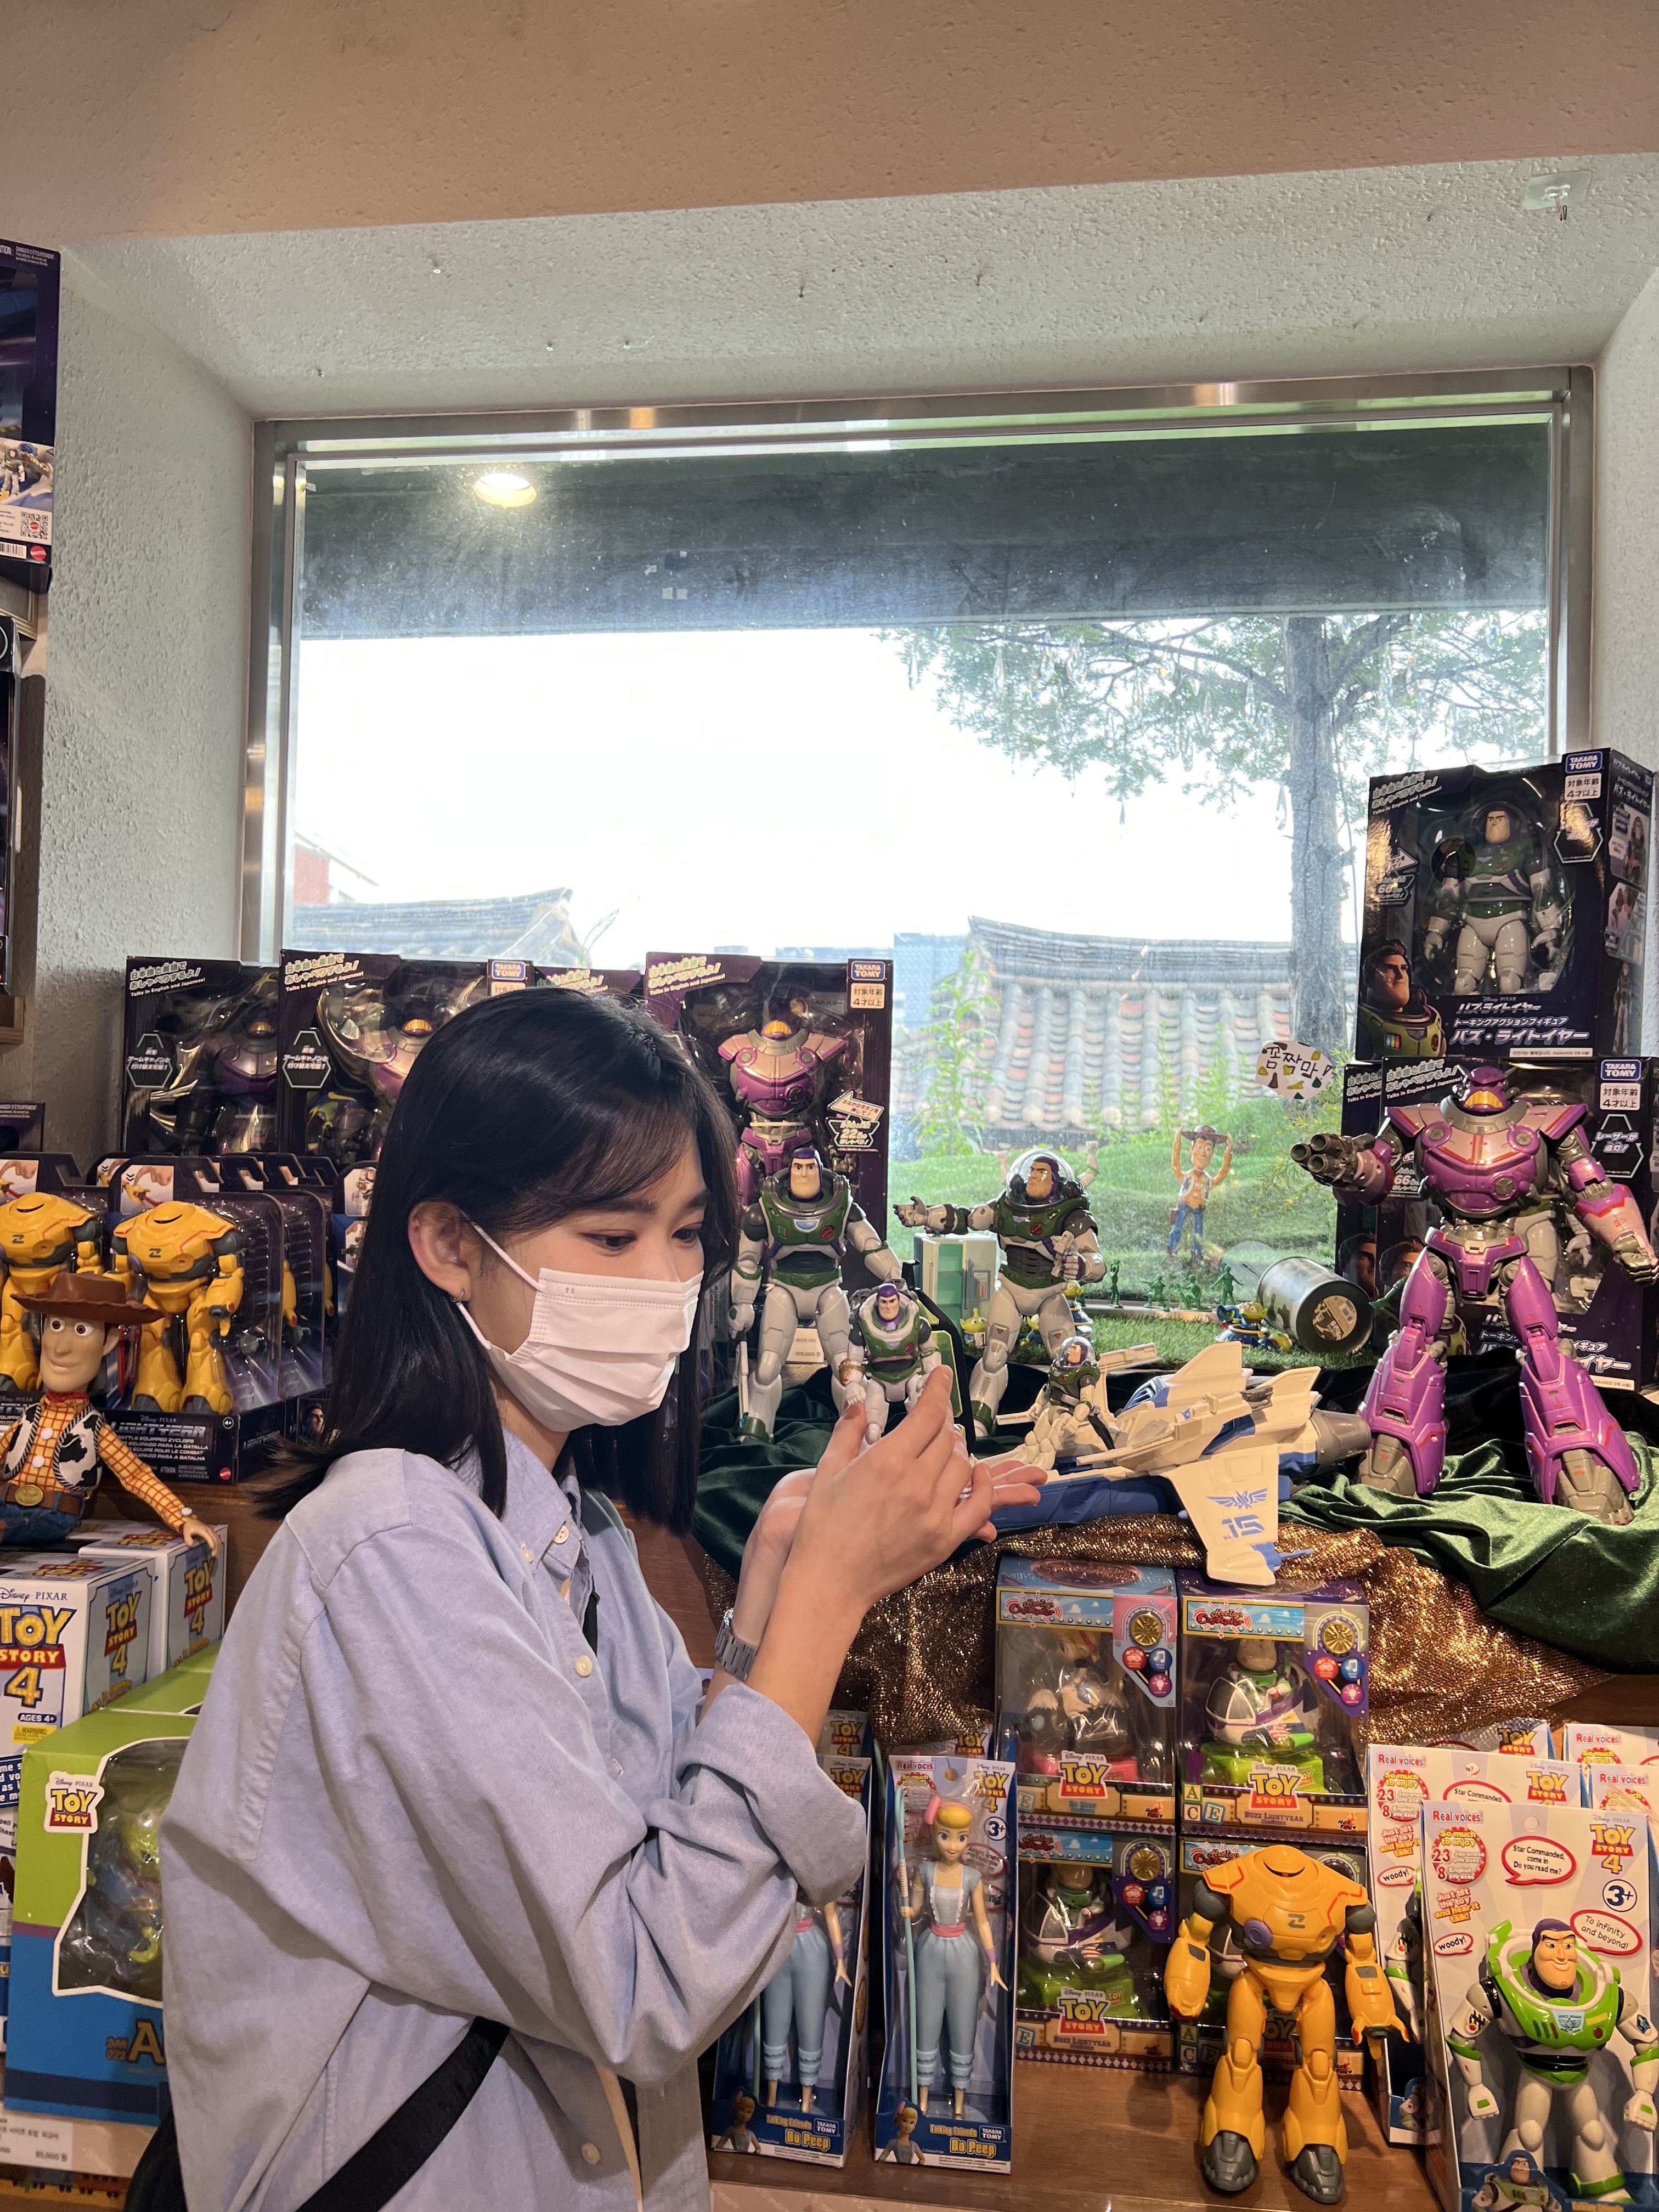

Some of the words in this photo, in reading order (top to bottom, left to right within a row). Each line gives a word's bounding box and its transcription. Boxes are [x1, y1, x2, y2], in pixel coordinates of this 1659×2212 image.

[1569, 761, 1597, 770] TOMY
[1567, 778, 1599, 788] 対象年齢
[1567, 789, 1598, 798] 4才以上
[1454, 1016, 1568, 1027] トーキングアクションフィギュア
[1449, 1028, 1589, 1045] バズ・ライトイヤー
[1407, 1085, 1425, 1094] English
[1437, 1076, 1462, 1087] Japanese!
[1603, 1088, 1638, 1096] 対象年齢
[1602, 1099, 1637, 1108] 4才以上
[1595, 1131, 1638, 1142] レーザーが
[1221, 1514, 1265, 1538] 15
[185, 1558, 216, 1596] TOY
[0, 1587, 30, 1602] Disney
[36, 1591, 67, 1601] PIXAR
[187, 1589, 211, 1610] STORY
[106, 1591, 142, 1632] TOY
[0, 1604, 77, 1647] TOY
[190, 1606, 205, 1635] 4
[109, 1626, 135, 1647] STORY
[0, 1649, 60, 1663] STORY
[111, 1644, 128, 1675] 4
[4, 1664, 44, 1709] 4
[20, 1714, 42, 1722] AGES
[830, 1720, 864, 1736] TOY
[958, 1733, 988, 1747] TOY
[1498, 1728, 1537, 1746] TOY
[1576, 1733, 1593, 1743] Real
[1596, 1734, 1621, 1744] voices!
[1063, 1751, 1082, 1761] Disney
[1378, 1753, 1397, 1764] Real
[1399, 1756, 1426, 1767] voices!
[897, 1761, 912, 1770] Real
[913, 1761, 936, 1771] voices!
[1060, 1762, 1109, 1784] TOY
[1528, 1762, 1545, 1771] Disney
[55, 1778, 73, 1787] Disney
[830, 1768, 866, 1784] TOY
[974, 1771, 1009, 1789] TOY
[1526, 1771, 1569, 1791] TOY
[1599, 1773, 1619, 1784] Real
[1621, 1774, 1649, 1785] voices!
[1065, 1786, 1102, 1795] STORY
[1250, 1773, 1302, 1797] TOY
[1186, 1786, 1199, 1799] A
[1378, 1789, 1395, 1801] 23
[1531, 1791, 1564, 1799] STORY
[50, 1788, 98, 1814] TOY
[981, 1797, 998, 1813] 4
[1256, 1797, 1293, 1806] STORY
[1187, 1806, 1199, 1819] C
[1207, 1805, 1221, 1820] E
[1382, 1805, 1390, 1818] 8
[1432, 1810, 1453, 1821] Real
[1454, 1811, 1483, 1822] voices!
[54, 1814, 89, 1824] STORY
[989, 1820, 1006, 1837] 3+
[1381, 1828, 1398, 1837] Just
[1401, 1825, 1414, 1833] tilt
[1589, 1824, 1637, 1846] TOY
[1384, 1835, 1398, 1844] the
[1400, 1833, 1414, 1841] toy
[1452, 1839, 1476, 1847] enjoy
[1394, 1847, 1414, 1858] talk!
[1432, 1849, 1451, 1863] 23
[1513, 1844, 1526, 1853] Star
[1527, 1847, 1565, 1860] Commanded,
[1595, 1844, 1630, 1854] STORY
[1535, 1864, 1549, 1872] read
[1601, 1854, 1623, 1875] 4
[1383, 1869, 1410, 1882] woody!
[1437, 1866, 1446, 1880] 8
[1436, 1890, 1456, 1901] Just
[1456, 1887, 1471, 1898] tilt
[1606, 1885, 1634, 1906] 3+
[1438, 1899, 1454, 1909] the
[1454, 1896, 1471, 1906] toy
[1435, 1910, 1451, 1919] and
[1452, 1904, 1471, 1915] hear
[1471, 1901, 1481, 1910] it
[1449, 1912, 1471, 1923] talk!
[1585, 1915, 1594, 1925] To
[1596, 1920, 1626, 1938] infinity
[1438, 1936, 1466, 1951] woody!
[1581, 1926, 1596, 1936] and
[1597, 1931, 1629, 1950] beyond!
[1059, 1998, 1110, 2023] TOY
[1065, 2022, 1101, 2031] STORY
[1183, 2048, 1195, 2062] C
[817, 2126, 836, 2134] TOMY
[786, 2129, 801, 2145] Bo
[802, 2131, 831, 2152] Peep
[950, 2137, 967, 2154] Bo
[967, 2139, 997, 2159] Peep
